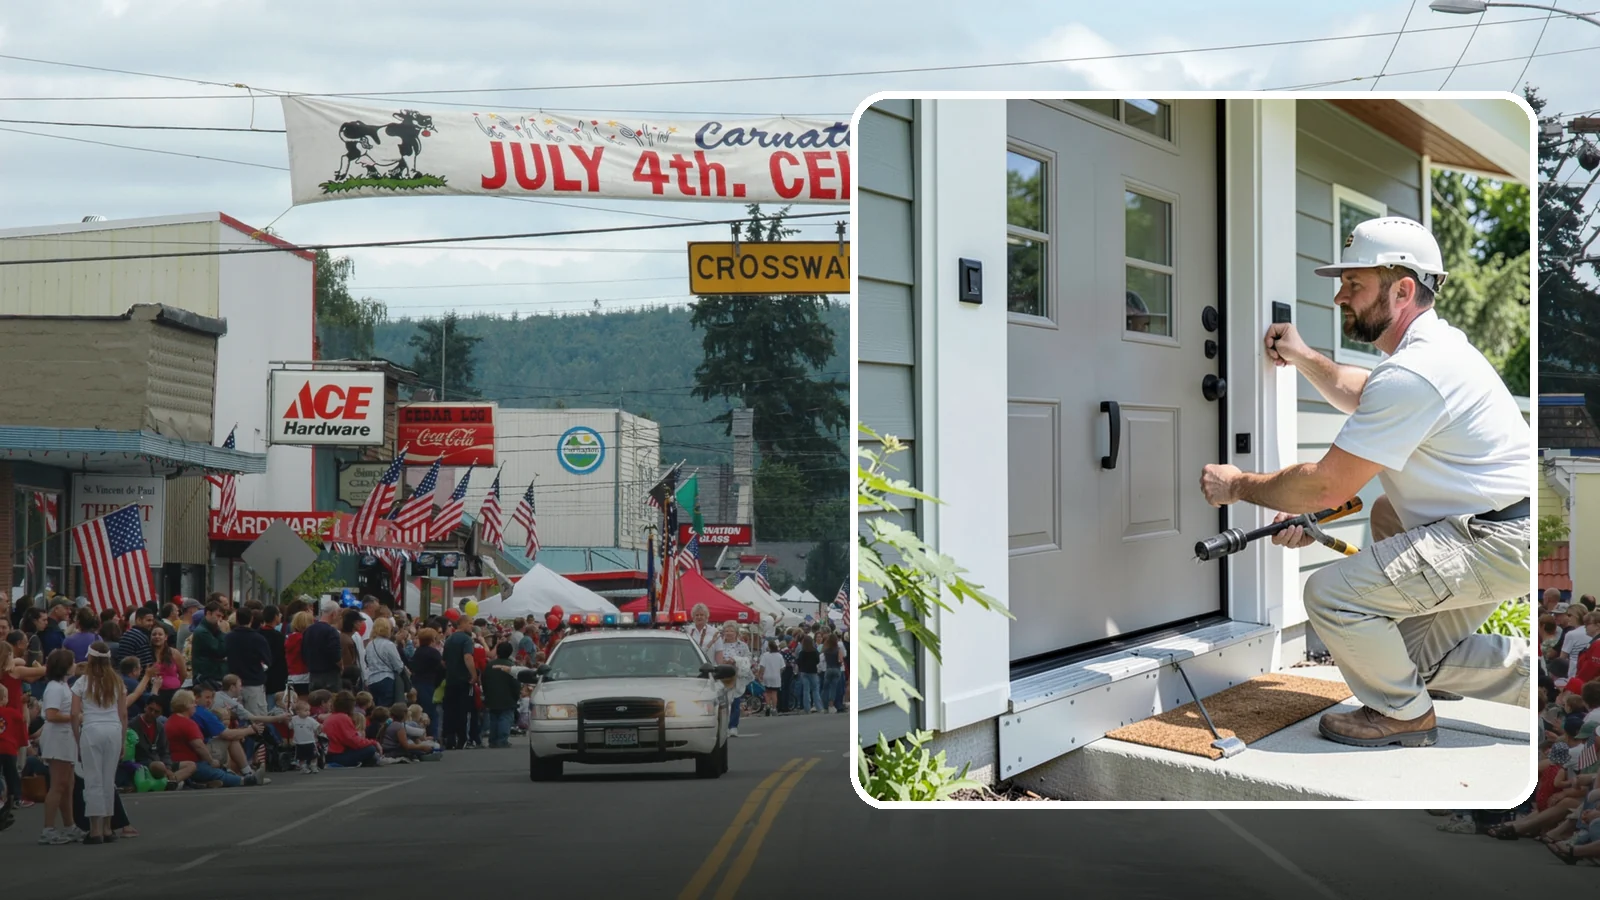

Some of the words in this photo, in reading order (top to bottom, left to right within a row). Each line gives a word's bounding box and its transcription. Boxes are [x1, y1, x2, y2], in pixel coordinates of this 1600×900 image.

[481, 141, 605, 193] JULY
[632, 149, 747, 198] 4th.
[696, 253, 850, 280] CROSSWA
[282, 379, 373, 420] ACE
[405, 408, 452, 422] CEDAR
[461, 408, 485, 422] LOG
[283, 421, 371, 437] Hardware
[416, 428, 477, 447] Coca-Cola
[353, 466, 385, 482] Simpl
[96, 485, 124, 495] Vincent
[126, 486, 135, 494] de
[137, 486, 155, 495] Paul
[688, 526, 741, 535] CRNATION
[699, 535, 730, 543] GLASS
